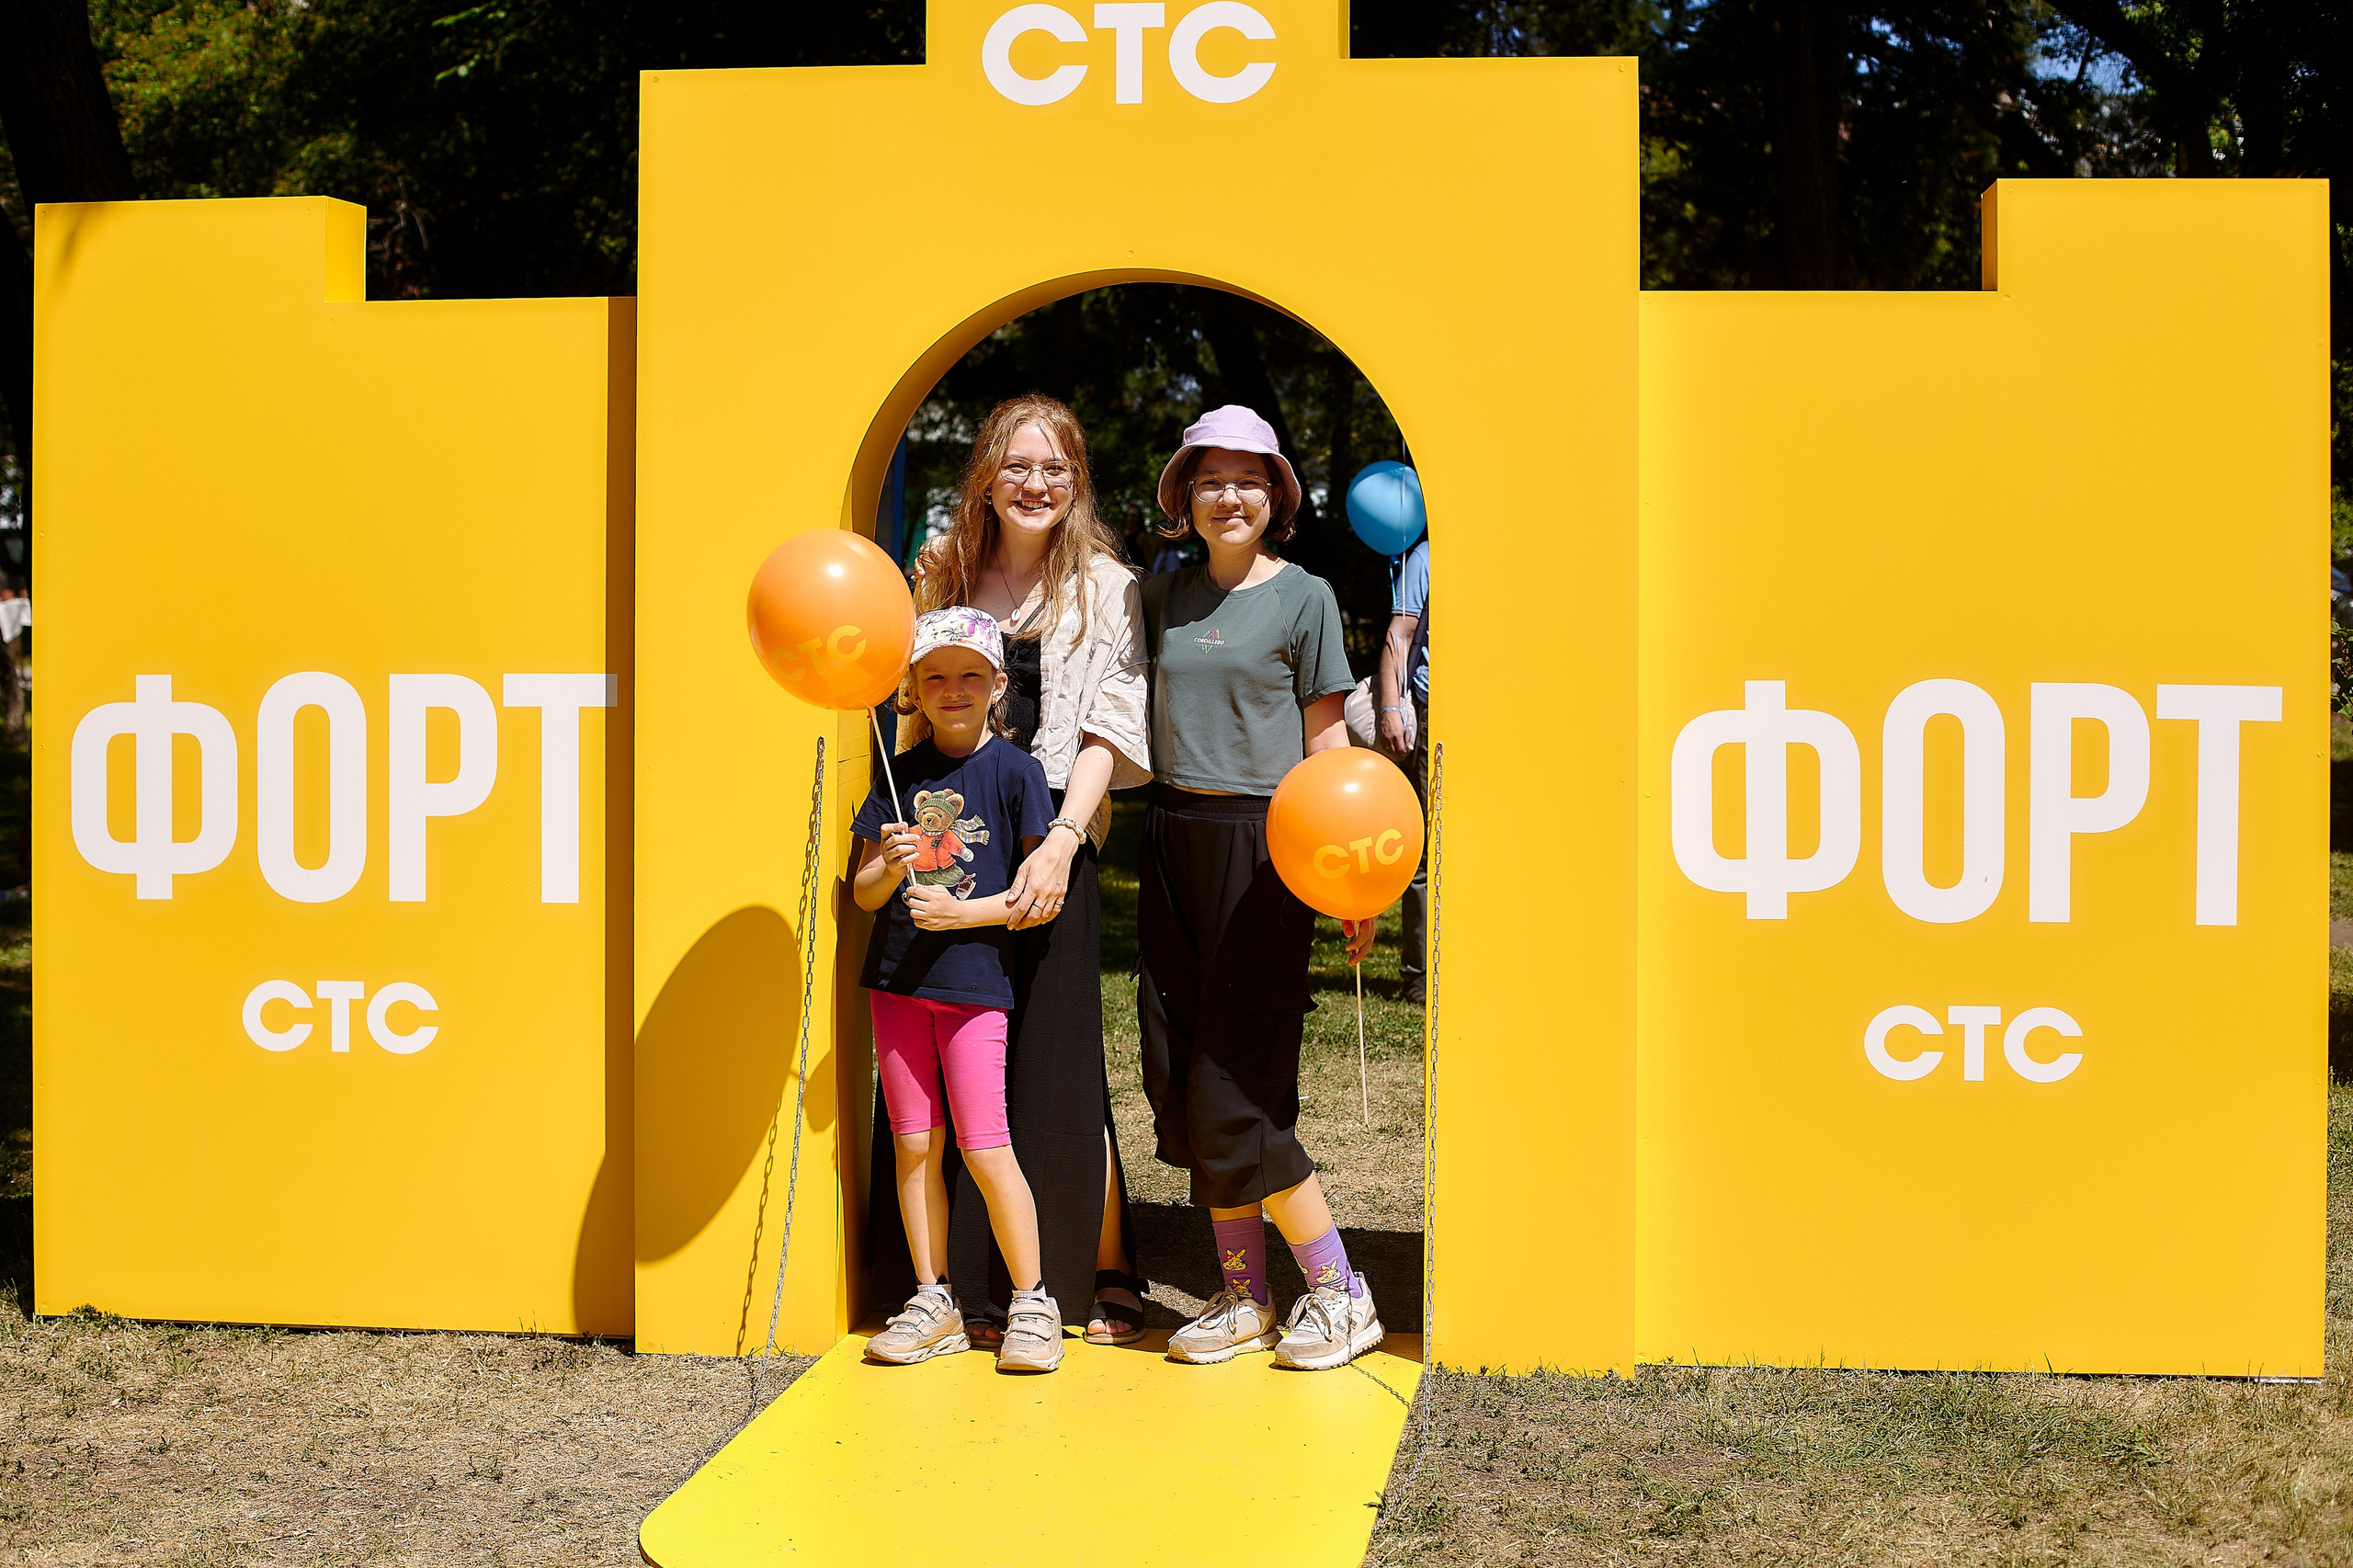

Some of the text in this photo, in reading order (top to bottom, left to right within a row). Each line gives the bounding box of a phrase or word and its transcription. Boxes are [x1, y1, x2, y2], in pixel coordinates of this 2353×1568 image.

[981, 0, 1277, 107] СТС
[771, 625, 867, 681] СТС
[71, 671, 618, 904] ФОРТ
[1670, 678, 2283, 926] ФОРТ
[1313, 829, 1404, 879] СТС
[242, 979, 439, 1055] СТС
[1864, 1005, 2084, 1084] СТС
